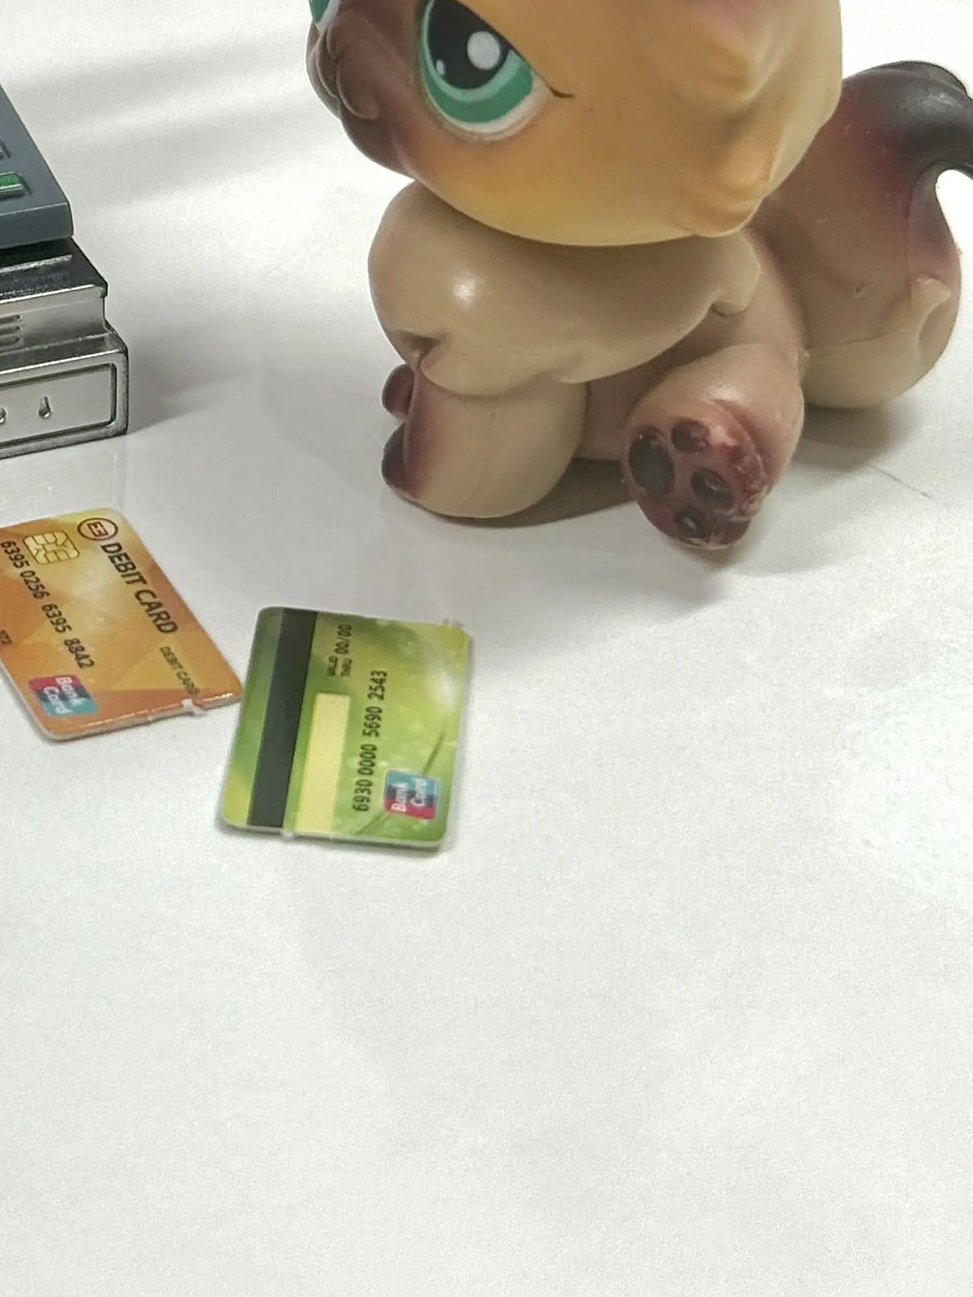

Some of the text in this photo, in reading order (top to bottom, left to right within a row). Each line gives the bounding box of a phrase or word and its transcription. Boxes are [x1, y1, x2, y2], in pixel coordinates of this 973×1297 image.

[100, 542, 179, 634] DEBIT CARD
[0, 540, 95, 669] 6395 0256 6395 8842
[334, 624, 352, 654] 00/00
[159, 646, 184, 672] DEBIT
[42, 686, 70, 714] Card
[55, 676, 84, 706] Bank
[352, 670, 388, 812] 6930 0000 5690 2543
[390, 784, 408, 812] Bank
[410, 778, 426, 807] Card
